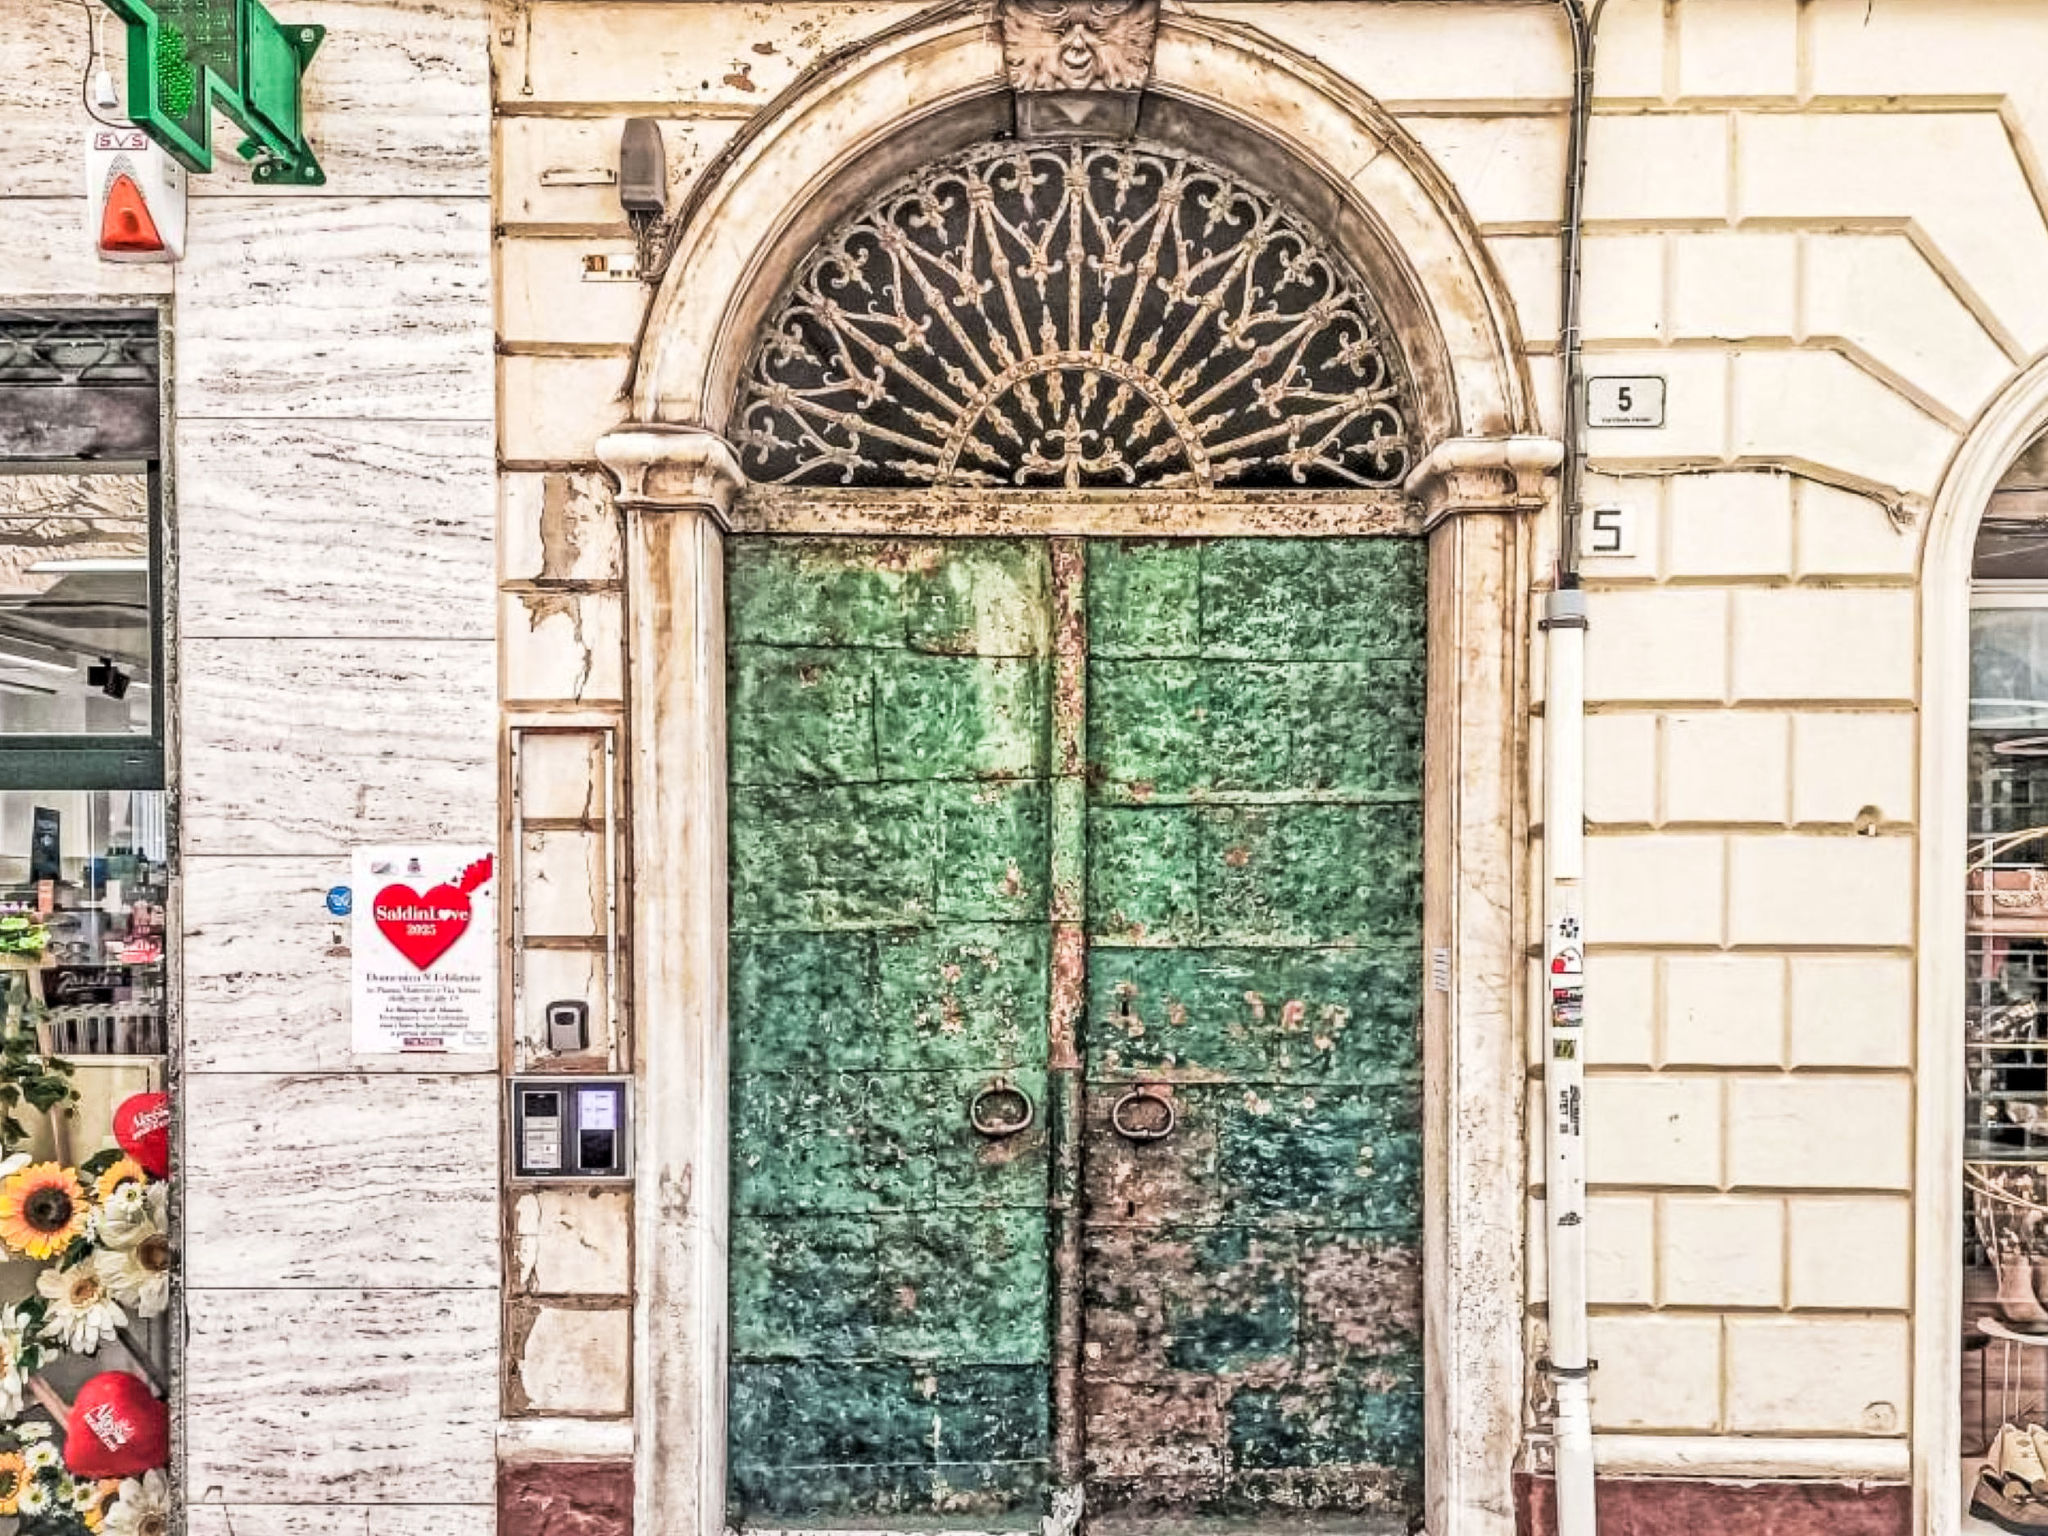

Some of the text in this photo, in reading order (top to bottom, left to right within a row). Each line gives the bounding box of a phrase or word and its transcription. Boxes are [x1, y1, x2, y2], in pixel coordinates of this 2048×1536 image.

[100, 134, 143, 147] SVS
[1619, 387, 1632, 411] 5
[1593, 510, 1621, 551] 5
